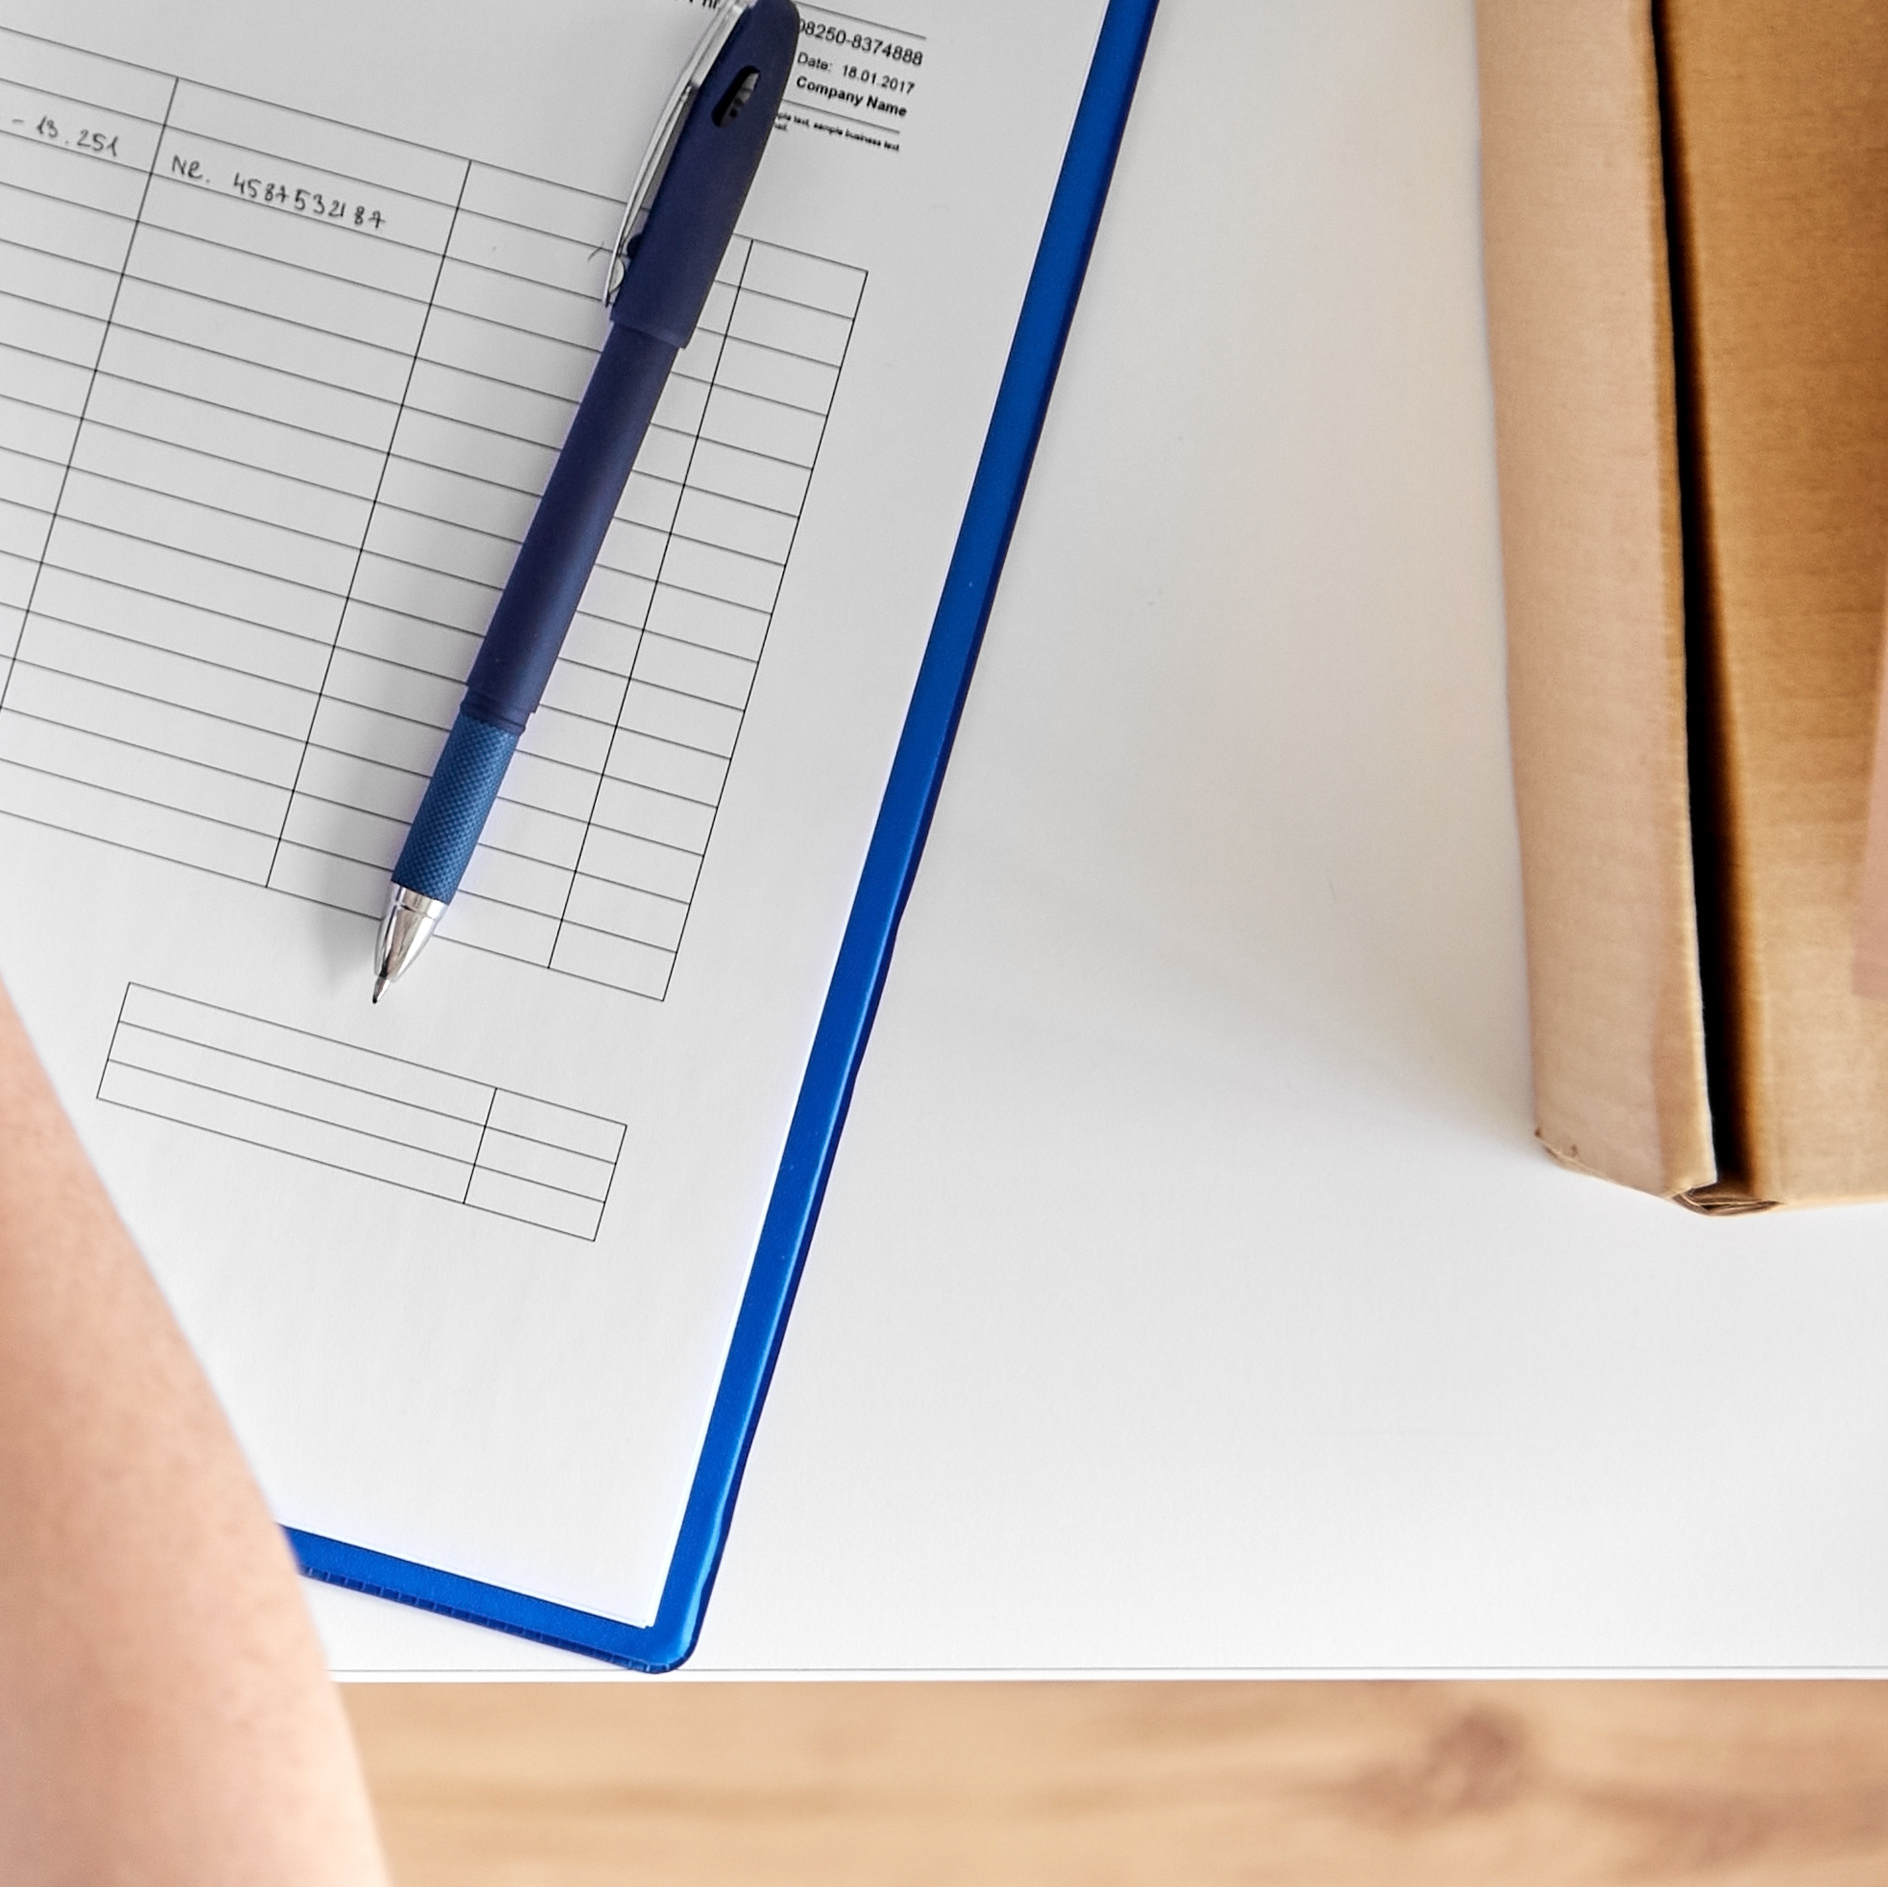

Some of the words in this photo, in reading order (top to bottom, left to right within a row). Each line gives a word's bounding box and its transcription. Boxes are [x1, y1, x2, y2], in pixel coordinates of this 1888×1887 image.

[796, 51, 833, 72] Date:
[842, 64, 915, 95] 18.01.2017
[796, 75, 864, 107] Company
[866, 94, 908, 118] Name
